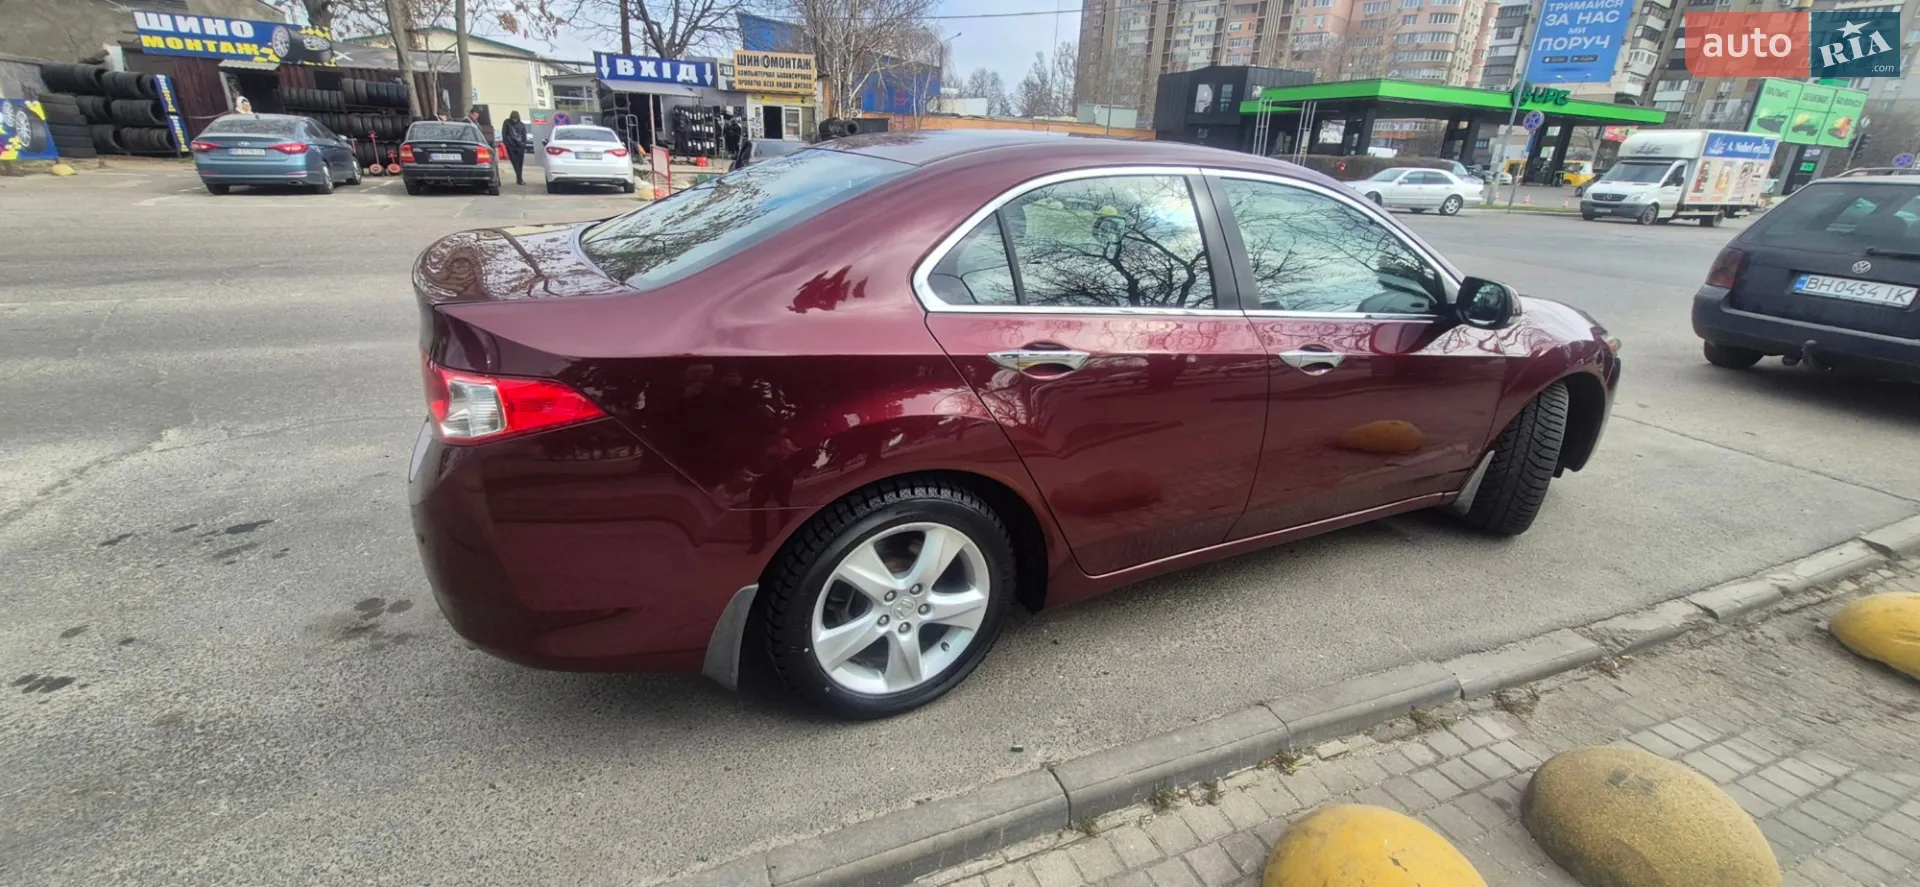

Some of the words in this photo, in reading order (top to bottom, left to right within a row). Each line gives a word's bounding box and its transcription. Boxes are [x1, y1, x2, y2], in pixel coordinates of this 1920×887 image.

[133, 12, 254, 38] ШИНО
[1544, 13, 1569, 27] ЗА
[1576, 10, 1620, 24] НАС
[140, 35, 260, 56] МОНТАЖ
[1538, 35, 1611, 51] ПОРУЧ
[616, 58, 698, 83] ВХІД
